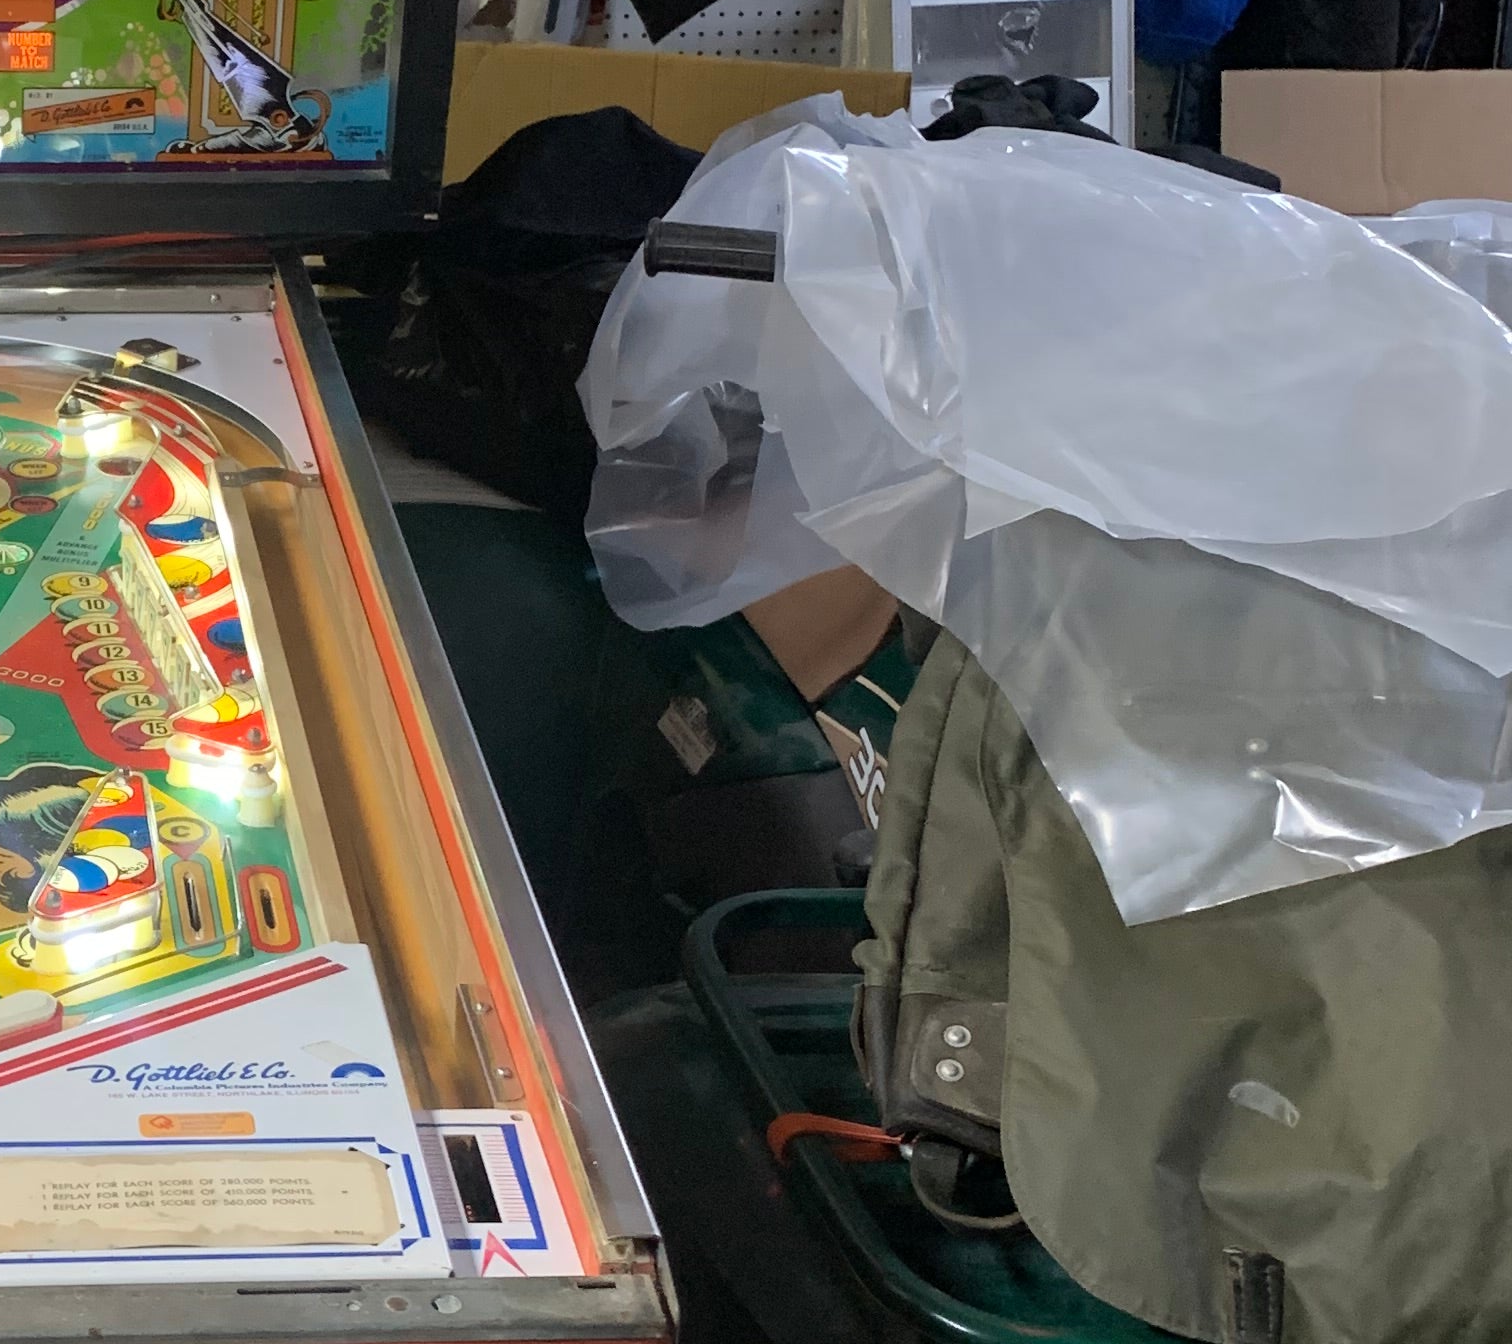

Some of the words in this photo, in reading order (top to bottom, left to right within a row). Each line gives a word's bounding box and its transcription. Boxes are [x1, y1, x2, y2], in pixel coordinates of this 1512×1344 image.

[7, 32, 53, 46] NUMBER
[19, 46, 38, 56] TO
[10, 56, 50, 69] MATCH
[41, 556, 98, 566] MULTIPLIER
[78, 576, 91, 587] 9
[86, 599, 105, 610] 10
[94, 622, 112, 634] 11
[103, 646, 125, 658] 12
[117, 670, 139, 682] 13
[132, 694, 154, 707] 14
[146, 722, 168, 736] 15
[170, 825, 191, 838] C
[68, 1064, 120, 1083] D.
[126, 1062, 237, 1091] Gottlieb
[261, 1062, 296, 1079] Co.
[155, 1083, 213, 1091] Columbia
[268, 1081, 329, 1089] Industries
[332, 1081, 388, 1089] Company
[96, 1181, 118, 1189] FOR
[123, 1180, 153, 1188] EACH
[158, 1178, 194, 1187] SCORE
[199, 1178, 214, 1186] OF
[52, 1193, 92, 1201] REPLAY
[97, 1191, 119, 1199] FOR
[124, 1190, 154, 1198] EACH
[159, 1188, 195, 1197] SCORE
[200, 1188, 216, 1196] OF
[53, 1203, 92, 1211] REPLAY
[98, 1202, 120, 1210] FOR
[125, 1200, 155, 1208] EACH
[160, 1199, 196, 1207] SCORE
[202, 1199, 217, 1207] OF
